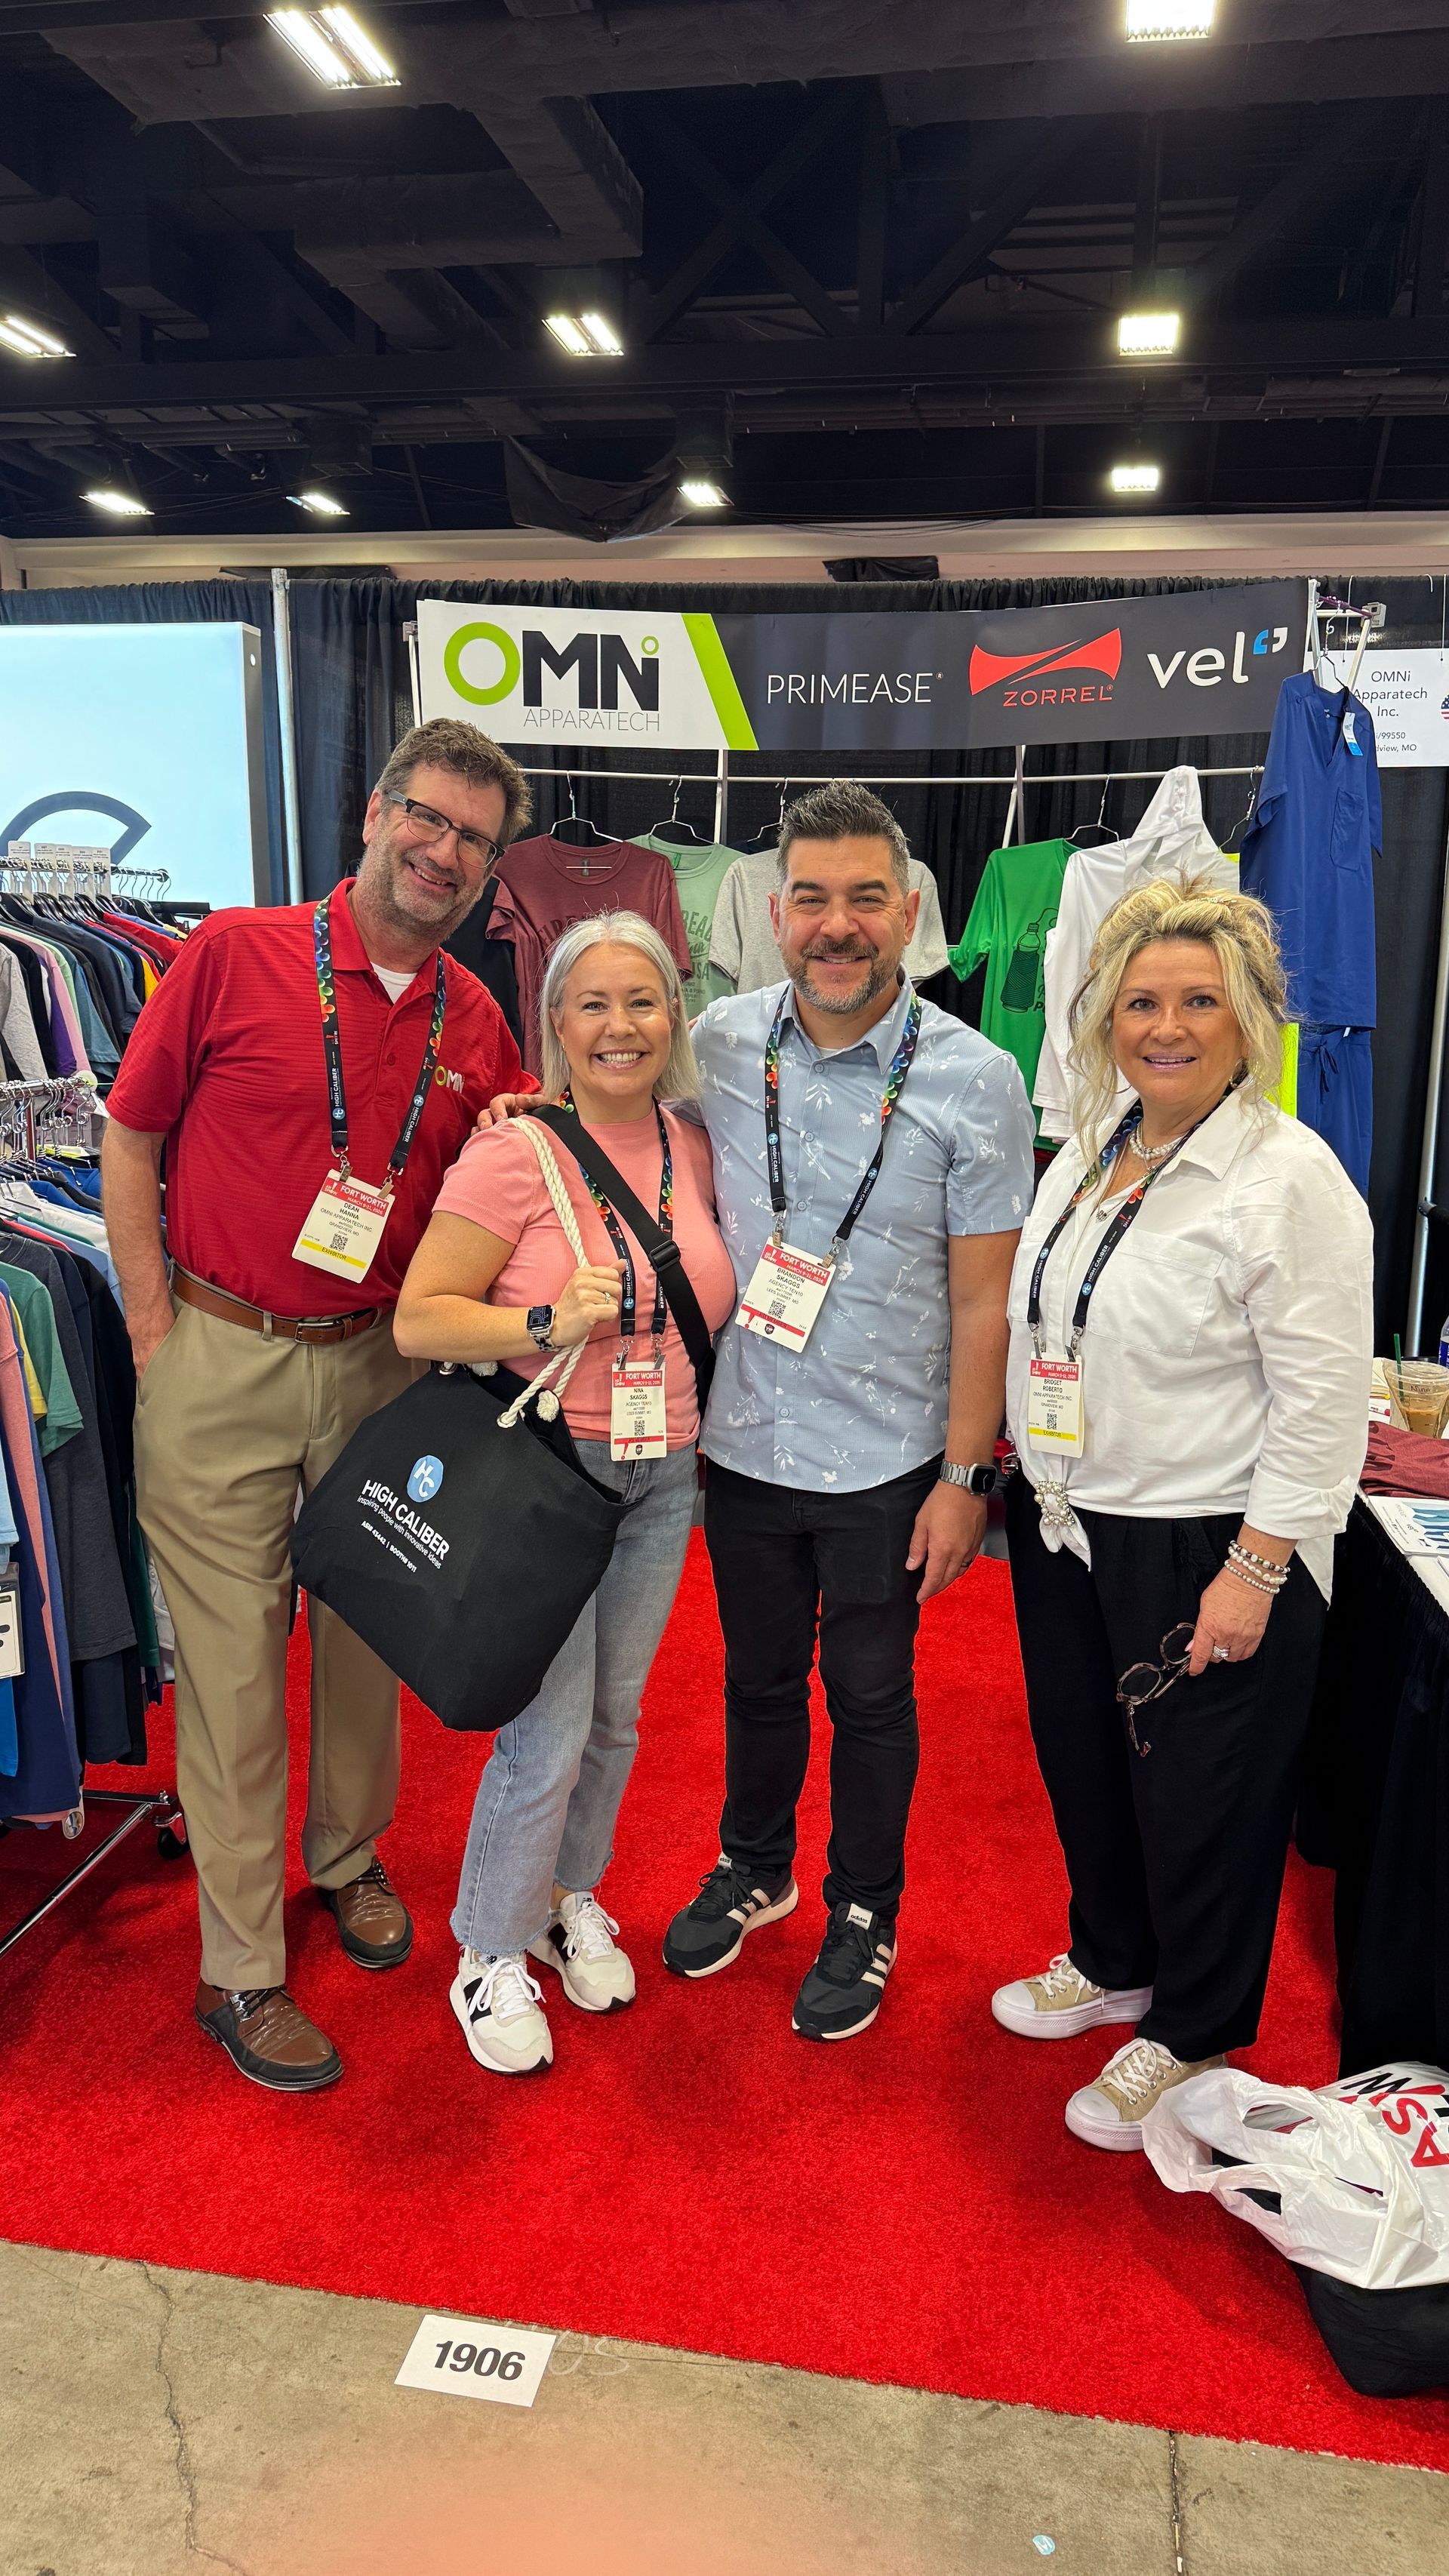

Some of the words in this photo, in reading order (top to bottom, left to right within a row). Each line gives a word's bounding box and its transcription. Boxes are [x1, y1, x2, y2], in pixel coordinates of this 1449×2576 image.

[1371, 670, 1411, 682] OMNi
[1354, 687, 1427, 703] Apparatech
[1377, 706, 1399, 717] Inc.
[523, 708, 660, 732] APPARATECH
[340, 1185, 359, 1198] FORT
[359, 1193, 386, 1209] WORTH
[347, 1196, 362, 1206] MARCH
[343, 1202, 359, 1212] DEAN
[339, 1208, 359, 1220] HANNA
[779, 1253, 798, 1265] FORT
[798, 1261, 827, 1278] WORTH
[786, 1264, 802, 1274] MARCH
[776, 1275, 800, 1288] SKAGGS
[777, 1267, 804, 1283] BRANDON
[768, 1279, 788, 1290] AGENCY
[361, 1479, 399, 1512] HIGH
[395, 1503, 450, 1561] CALIBER
[378, 1507, 394, 1526] people
[393, 1521, 405, 1535] with
[404, 1529, 429, 1556] innovative
[427, 1551, 442, 1570] ideas
[407, 1560, 417, 1574] 1011
[851, 1914, 868, 1924] adidas
[434, 2341, 526, 2381] 1906
